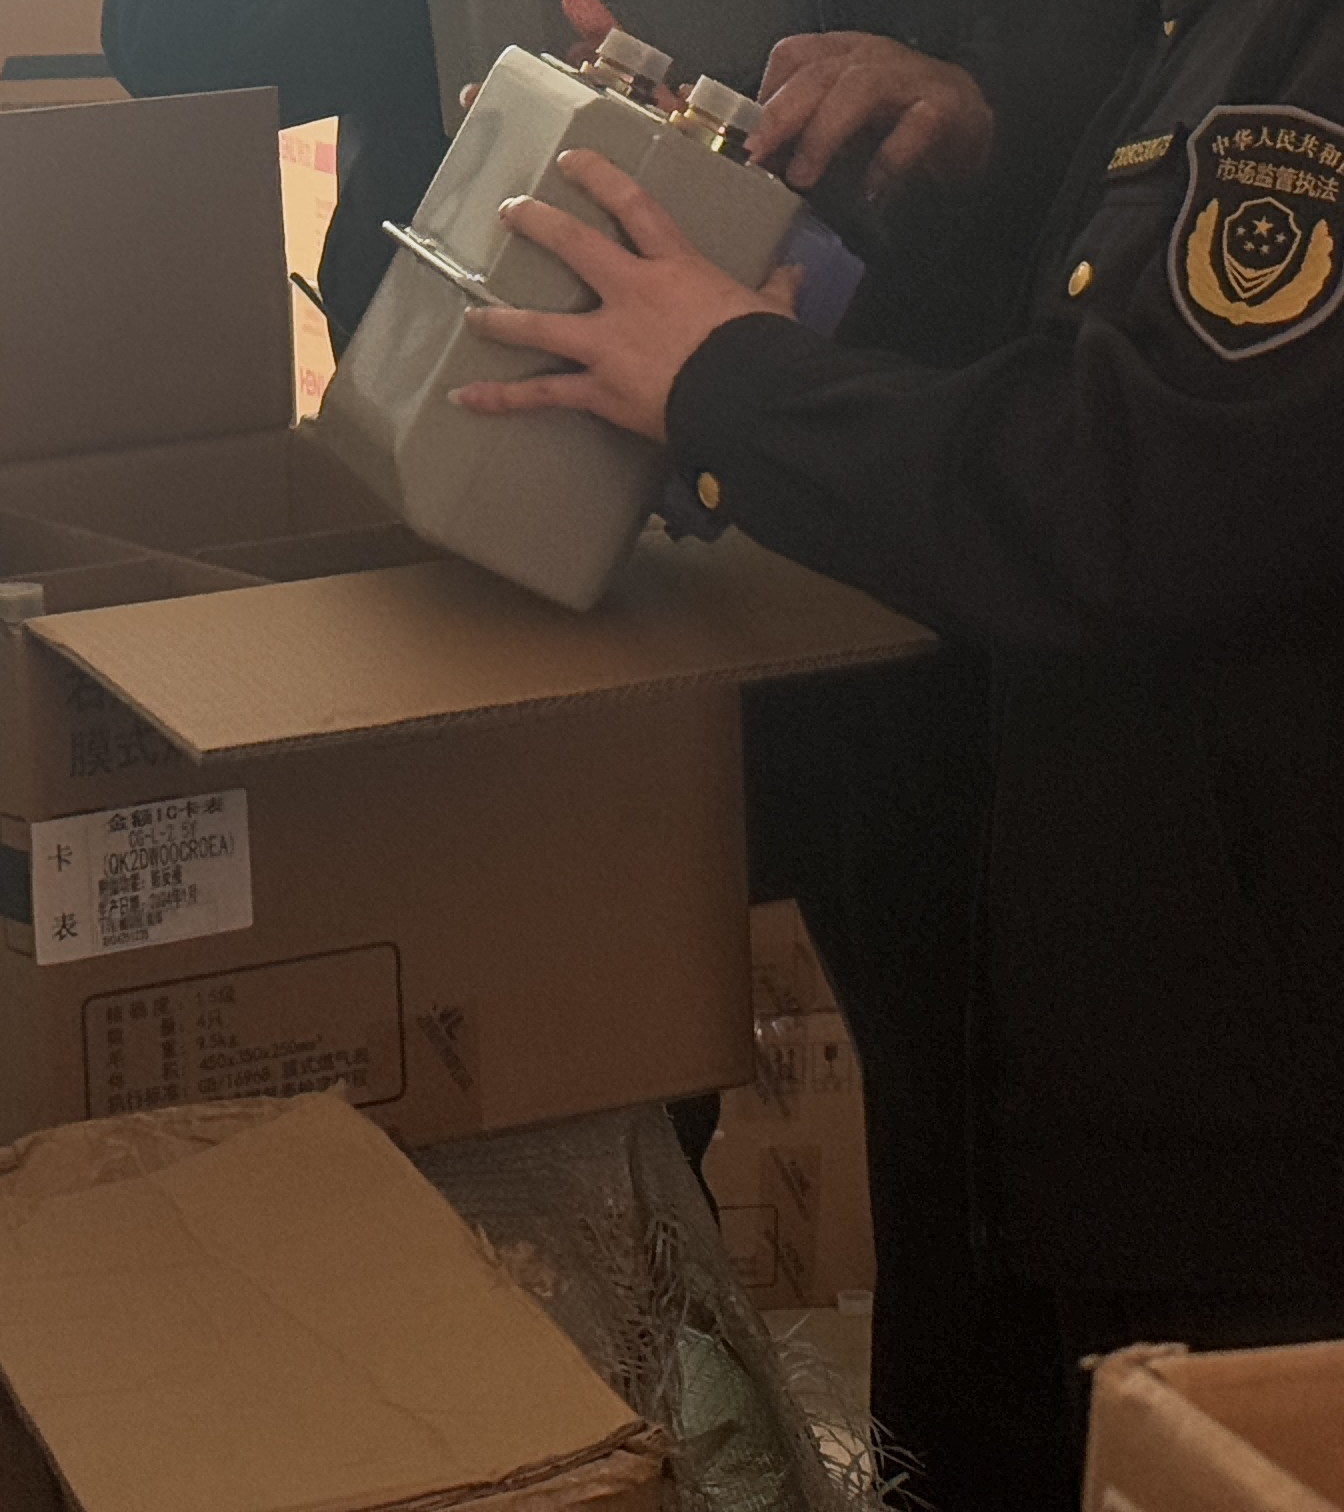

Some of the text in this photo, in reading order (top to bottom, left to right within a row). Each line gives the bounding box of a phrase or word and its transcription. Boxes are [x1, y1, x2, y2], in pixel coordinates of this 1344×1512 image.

[1215, 156, 1342, 204] 市场监管执法
[69, 715, 183, 778] 膜式
[106, 796, 224, 833] 金额IC卡表
